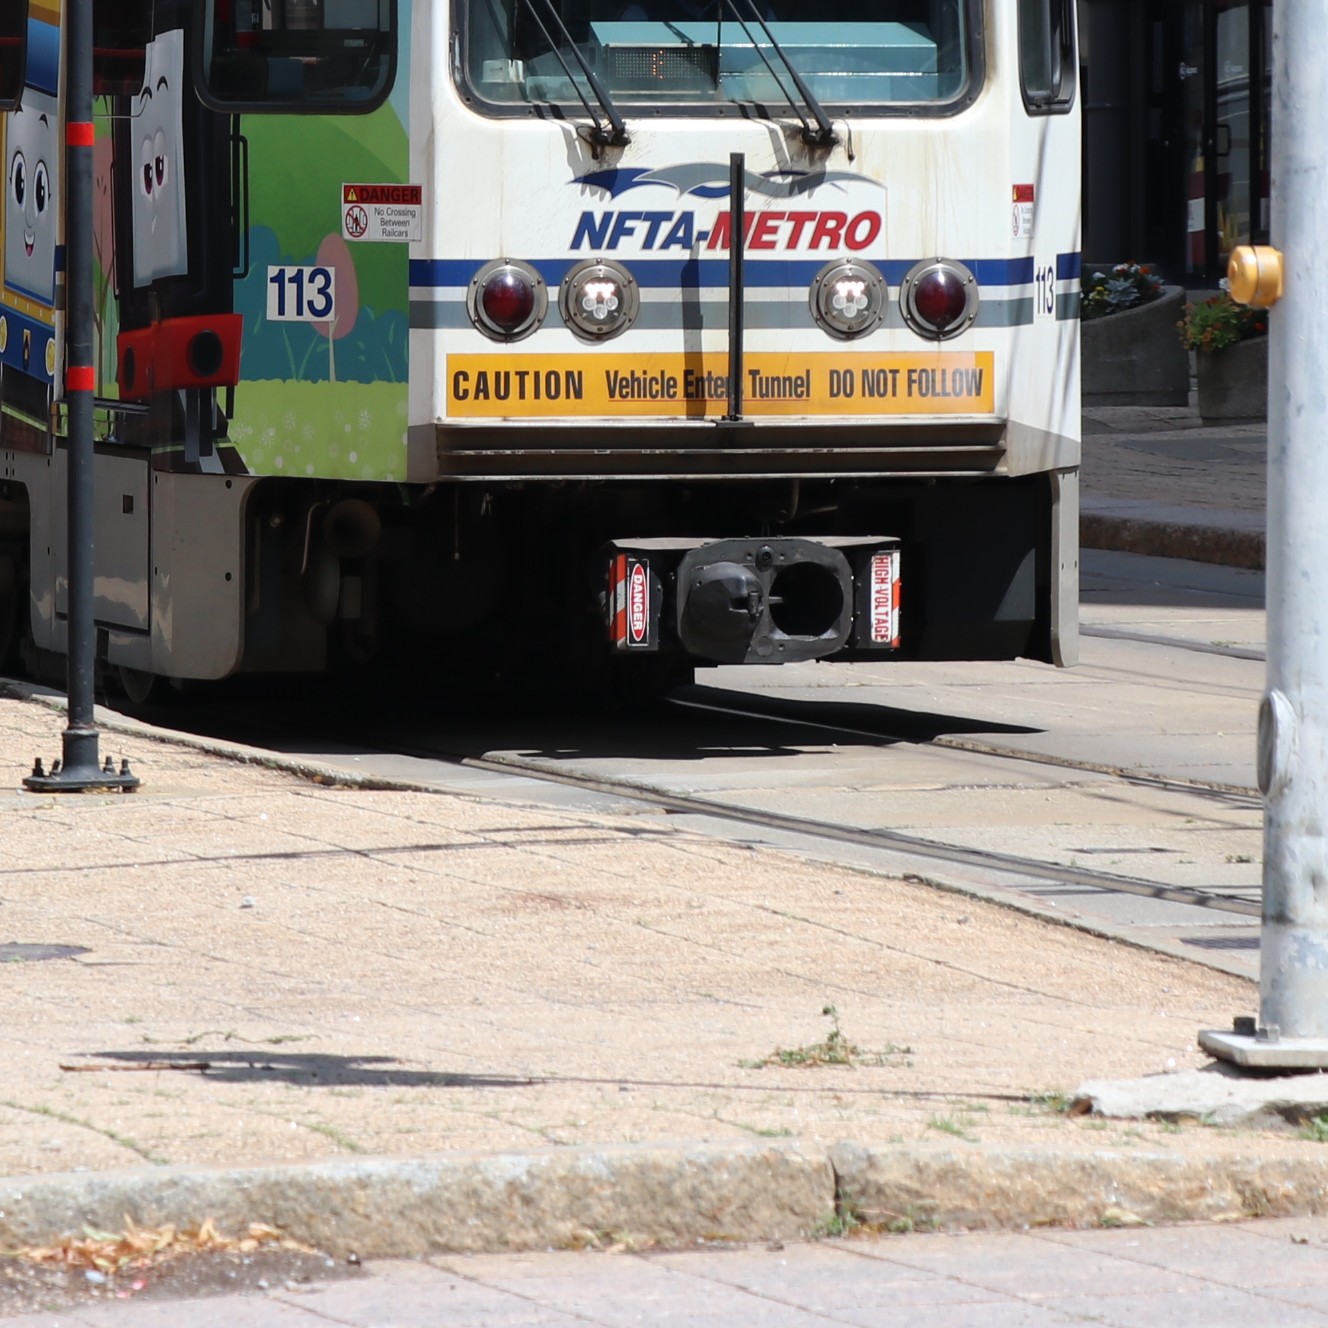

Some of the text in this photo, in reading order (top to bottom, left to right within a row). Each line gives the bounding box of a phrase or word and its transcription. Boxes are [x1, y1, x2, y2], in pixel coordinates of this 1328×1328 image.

[360, 188, 419, 202] DANGER
[374, 207, 416, 218] No Crossing
[380, 218, 410, 227] Between
[382, 228, 408, 238] Railcars
[569, 210, 883, 252] NFTA-METRO
[269, 267, 334, 318] 113
[1035, 265, 1054, 315] 113
[453, 370, 583, 400] CAUTION
[605, 369, 678, 399] Vehicle
[749, 369, 811, 399] Tunnel
[829, 369, 854, 398] DO
[861, 369, 900, 398] NOT
[907, 368, 983, 397] FOLLOW
[634, 574, 643, 630] DANGER
[875, 556, 889, 640] HIGH VOLTAGE
